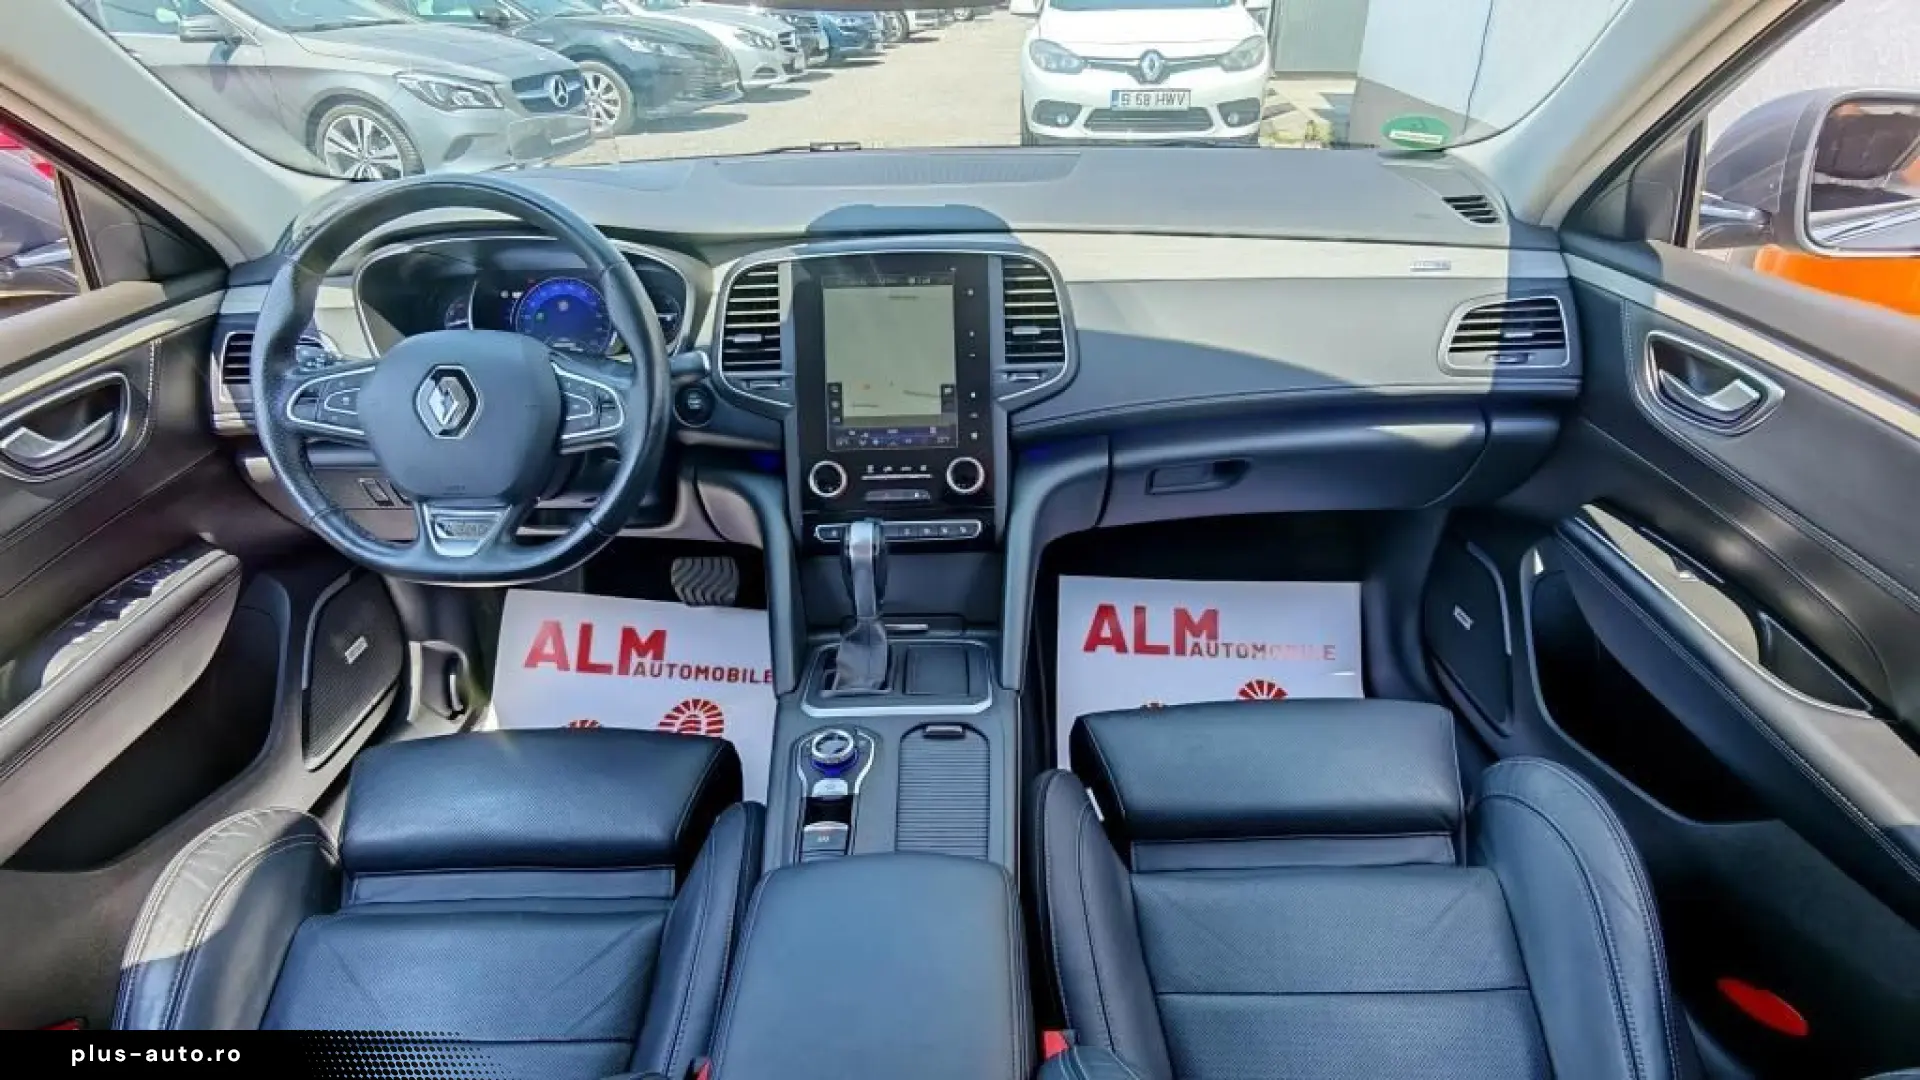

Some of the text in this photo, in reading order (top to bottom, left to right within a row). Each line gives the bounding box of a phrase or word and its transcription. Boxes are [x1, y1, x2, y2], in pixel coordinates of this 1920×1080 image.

[523, 620, 667, 675] ALM
[1083, 603, 1219, 656] ALM
[1190, 642, 1336, 661] AUTOMOE
[632, 661, 773, 684] AUTOMOBILE
